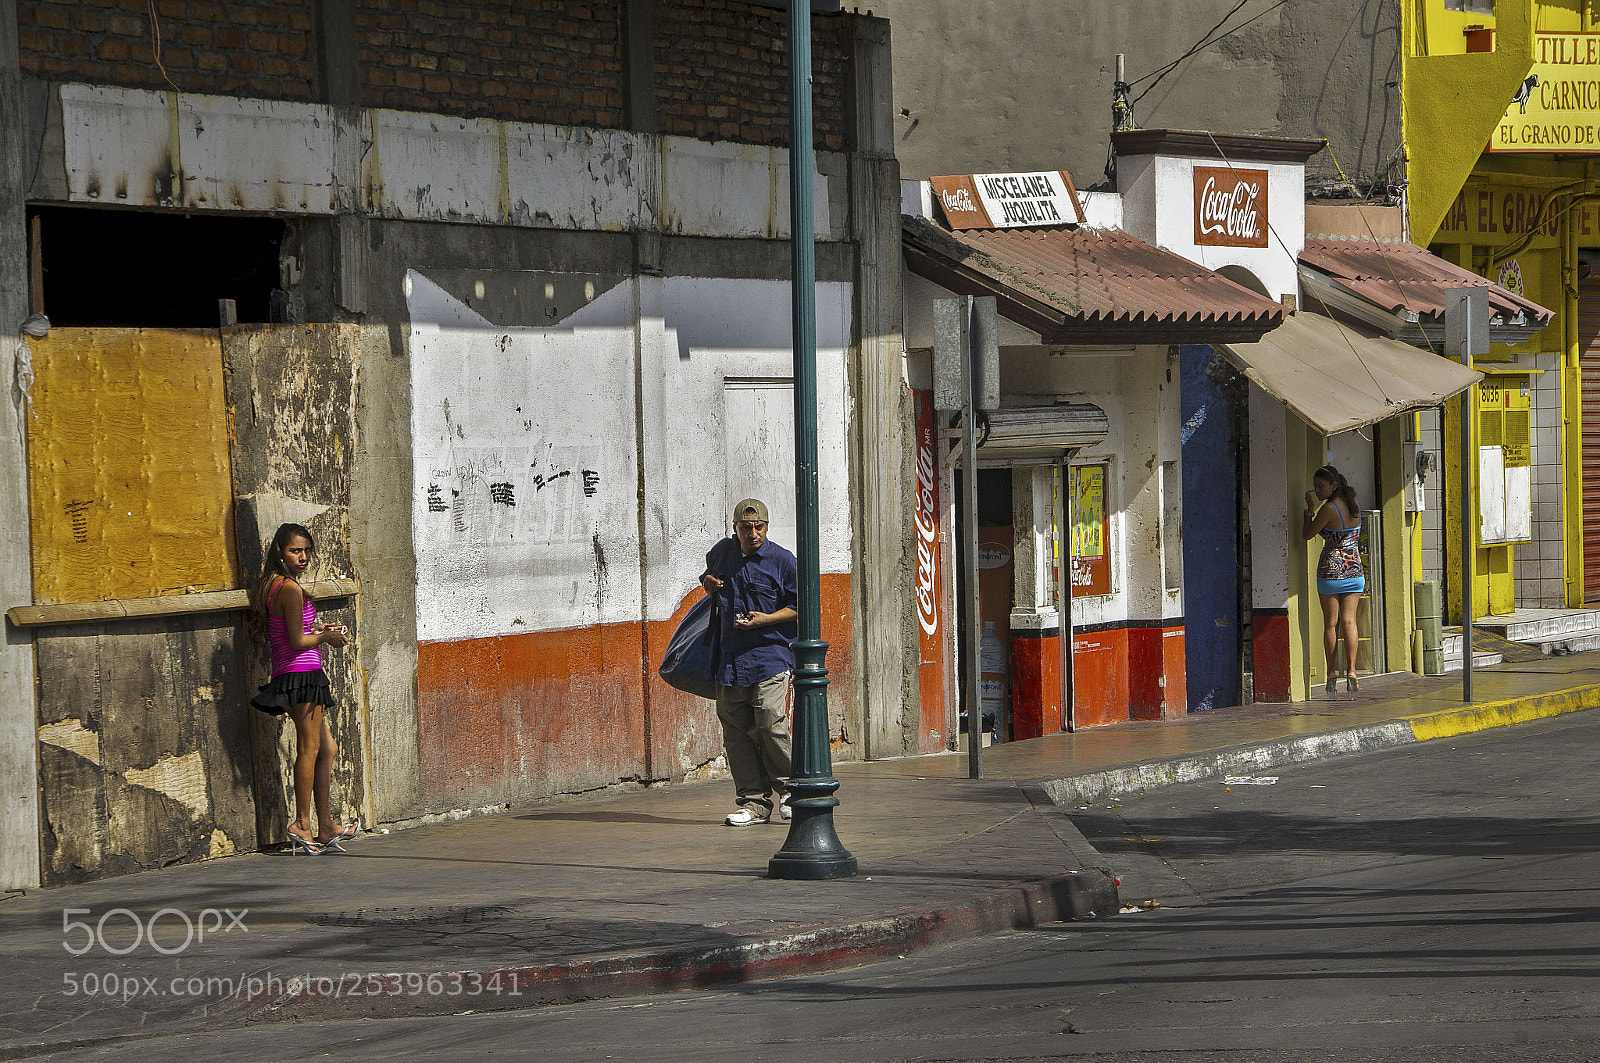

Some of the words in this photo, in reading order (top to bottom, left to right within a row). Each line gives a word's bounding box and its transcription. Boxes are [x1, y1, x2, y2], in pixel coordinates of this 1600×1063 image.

[1534, 37, 1600, 65] TILLE
[1540, 80, 1600, 110] CARNIC
[1500, 125, 1518, 144] EL
[1521, 124, 1571, 144] GRANO
[1574, 125, 1594, 144] DE
[981, 175, 1057, 200] MISCELANEA
[1001, 200, 1061, 225] JUQUILITA
[1200, 176, 1260, 239] Coca-Cola
[1477, 190, 1498, 233] EL
[1481, 385, 1500, 403] 8036
